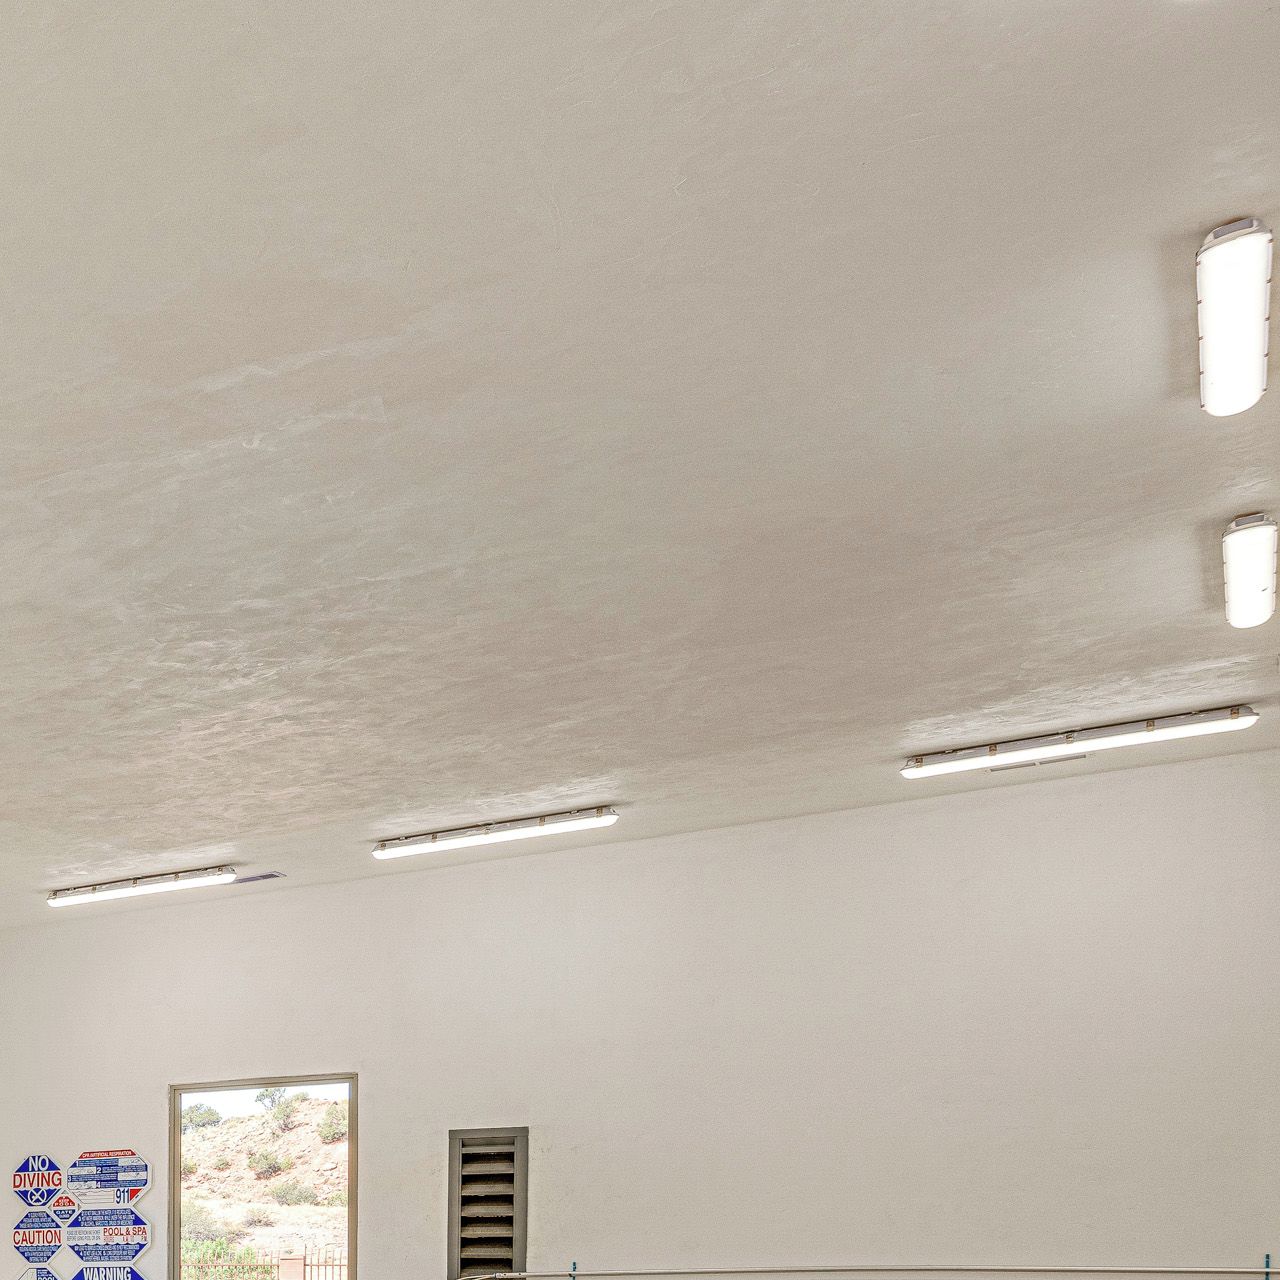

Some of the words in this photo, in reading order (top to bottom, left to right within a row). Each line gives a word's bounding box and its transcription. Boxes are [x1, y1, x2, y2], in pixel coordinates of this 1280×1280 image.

[28, 1156, 49, 1171] NO
[13, 1172, 62, 1188] DIVING
[116, 1189, 129, 1204] 911
[14, 1230, 61, 1245] CAUTION
[103, 1228, 124, 1236] POOL
[126, 1227, 130, 1235] &
[132, 1226, 147, 1235] SPA
